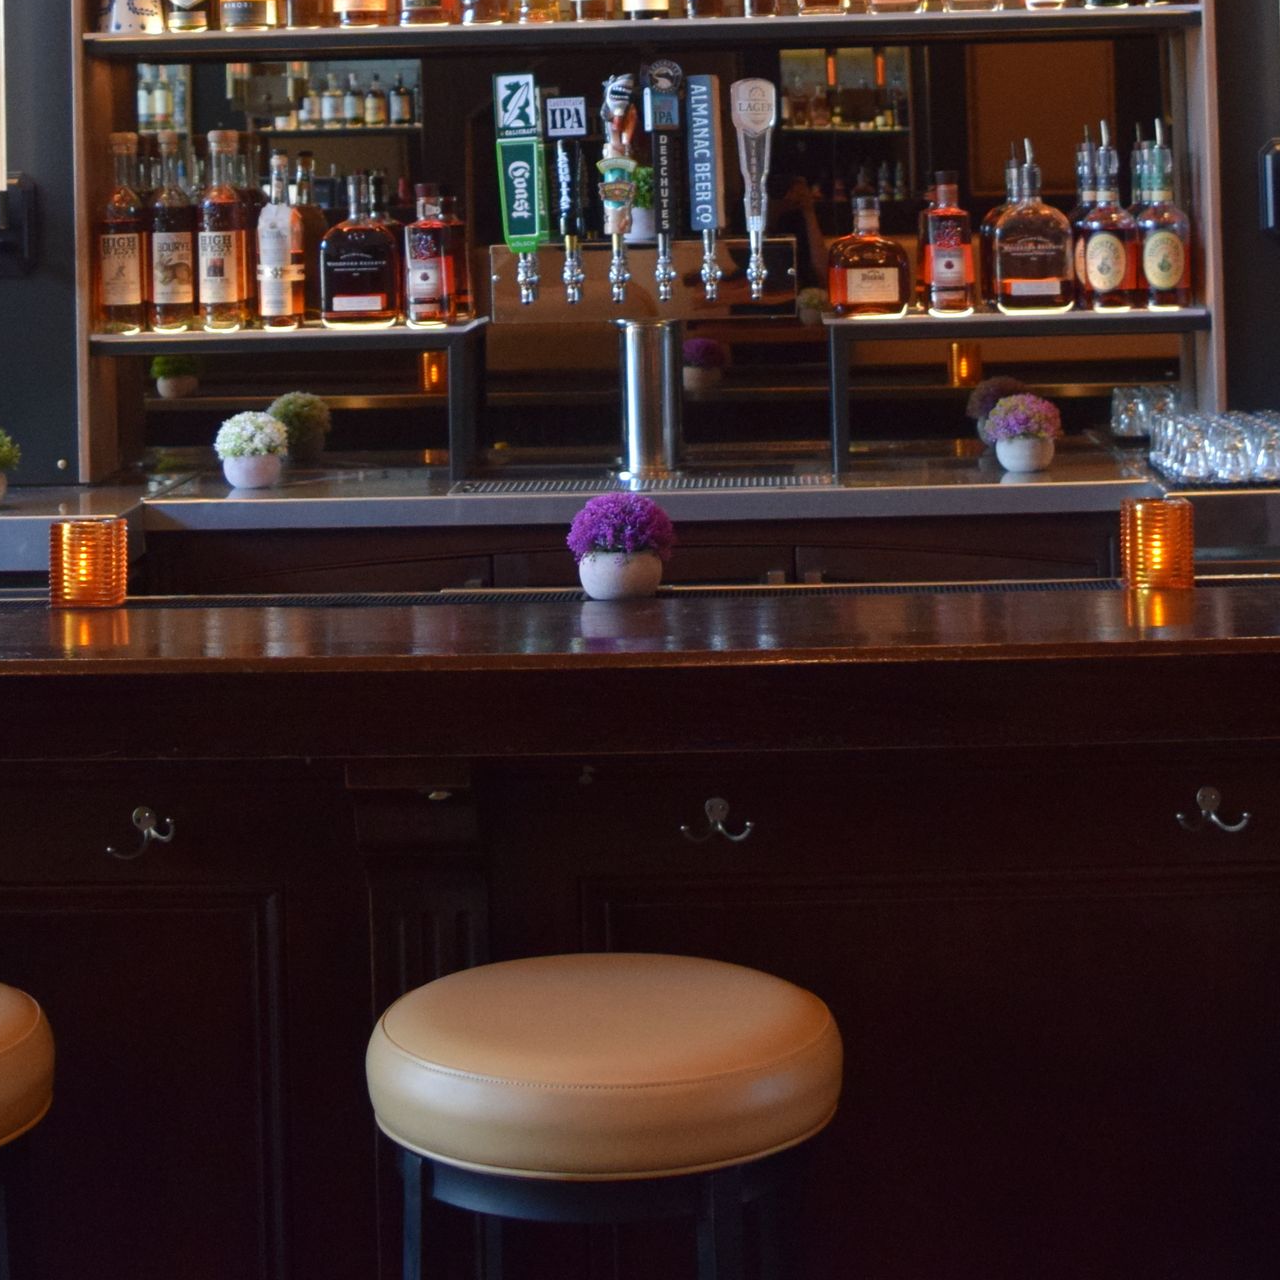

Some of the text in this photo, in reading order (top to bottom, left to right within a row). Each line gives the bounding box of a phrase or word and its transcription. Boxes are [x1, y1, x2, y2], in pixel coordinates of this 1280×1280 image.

[550, 107, 584, 130] IPA
[690, 84, 710, 158] ALMANAC
[659, 134, 669, 230] DESCHUTES
[694, 163, 712, 202] BEER
[103, 237, 136, 247] HIGH
[200, 234, 231, 245] HIGH
[103, 247, 135, 255] WEST
[200, 244, 231, 253] WEST
